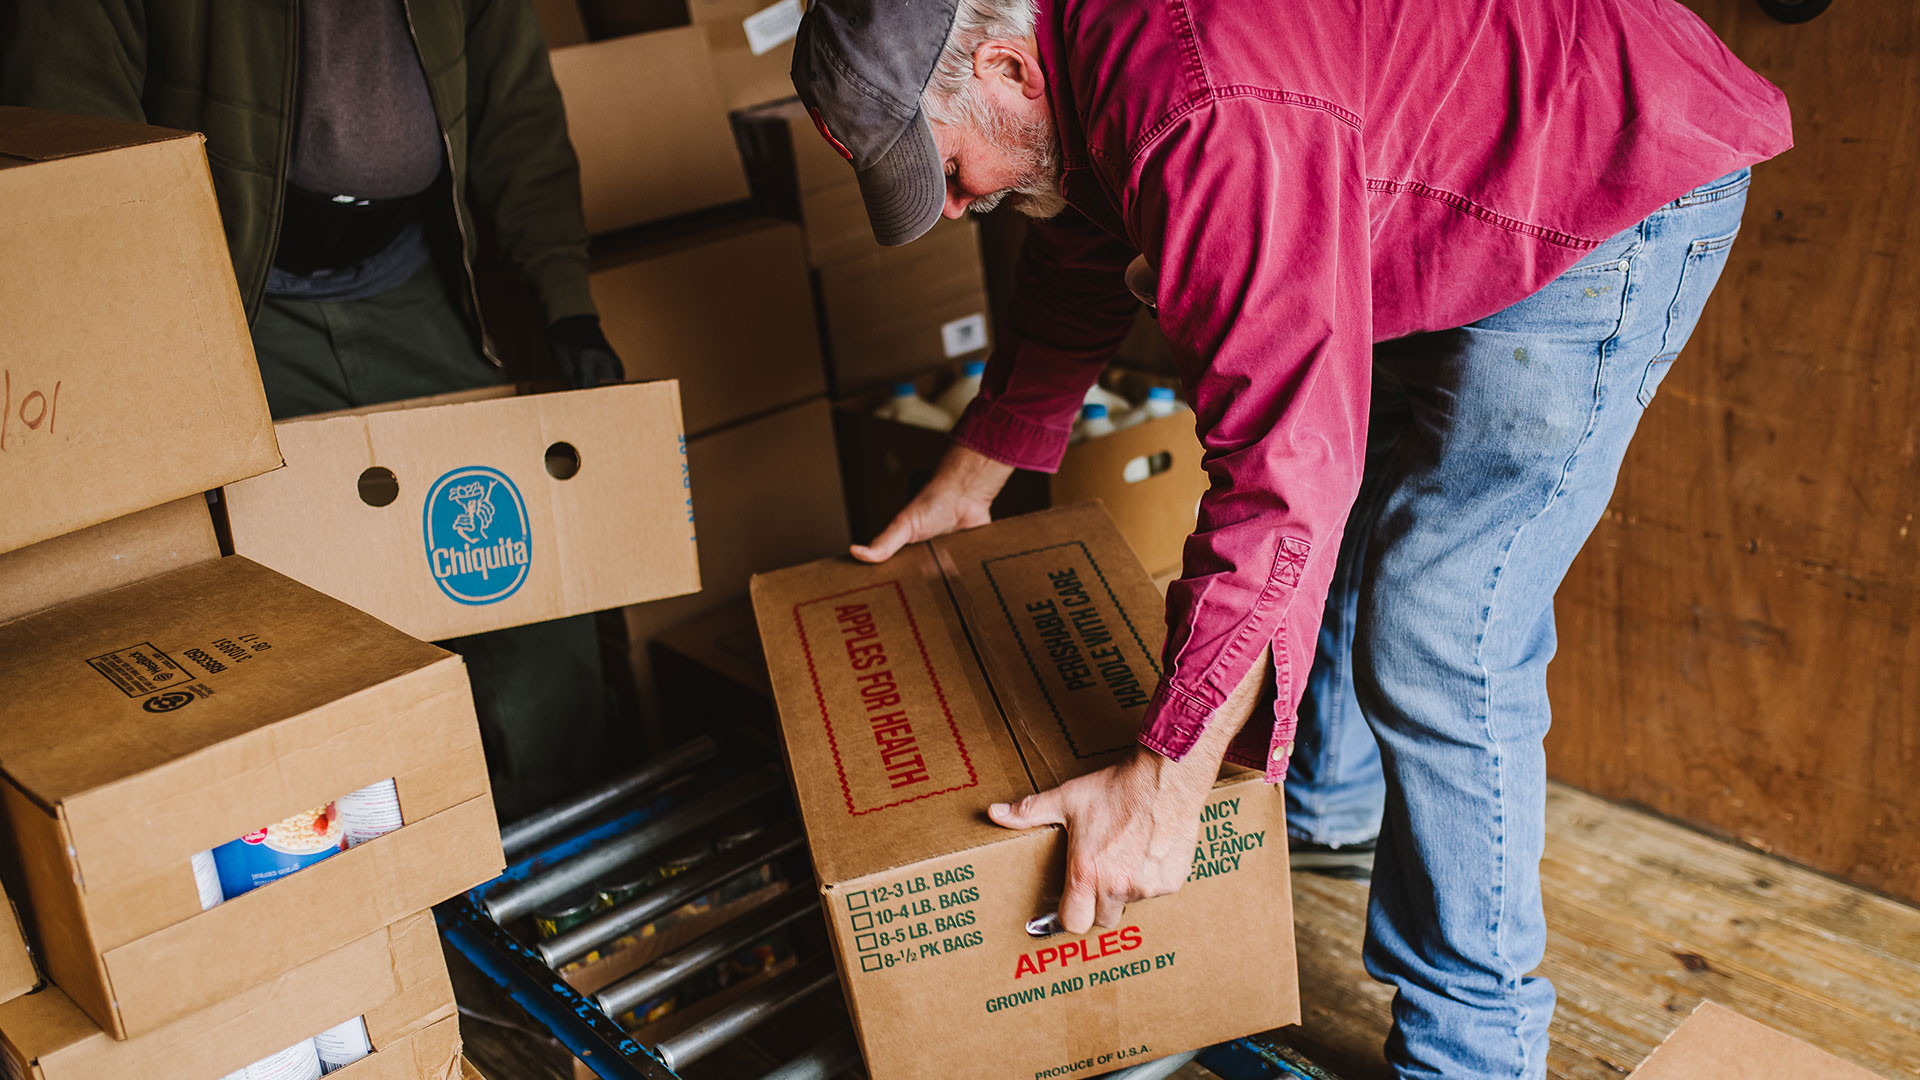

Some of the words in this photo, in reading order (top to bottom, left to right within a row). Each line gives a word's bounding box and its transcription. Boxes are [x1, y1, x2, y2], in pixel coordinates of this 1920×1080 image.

[432, 537, 529, 581] Chiquita
[1048, 567, 1091, 607] CARE
[834, 604, 888, 671] APPLES
[1026, 599, 1097, 692] PERISHABLE
[1069, 607, 1113, 648] WITH
[857, 670, 902, 712] FOR
[1091, 645, 1150, 709] HANDLE
[869, 710, 930, 789] HEALTH
[1206, 821, 1238, 842] U.S.
[1210, 830, 1266, 859] FANCY
[870, 882, 904, 903] 12-3
[906, 876, 930, 895] LB.
[933, 864, 975, 888] BAGS
[875, 904, 909, 925] 10-4
[911, 898, 936, 916] LB.
[939, 886, 980, 909] BAGS
[879, 928, 906, 947] 8-5
[908, 922, 932, 939] LB.
[935, 910, 976, 933] BAGS
[919, 940, 941, 959] PK
[943, 930, 984, 953] BAGS
[1014, 926, 1143, 980] APPLES
[985, 986, 1047, 1013] GROWN
[1050, 976, 1085, 997] AND
[1089, 958, 1151, 987] PACKED
[1155, 951, 1177, 970] BY
[1035, 1057, 1095, 1080] PRODUCE
[1097, 1052, 1114, 1065] OF
[1117, 1044, 1152, 1060] U.S.A.
